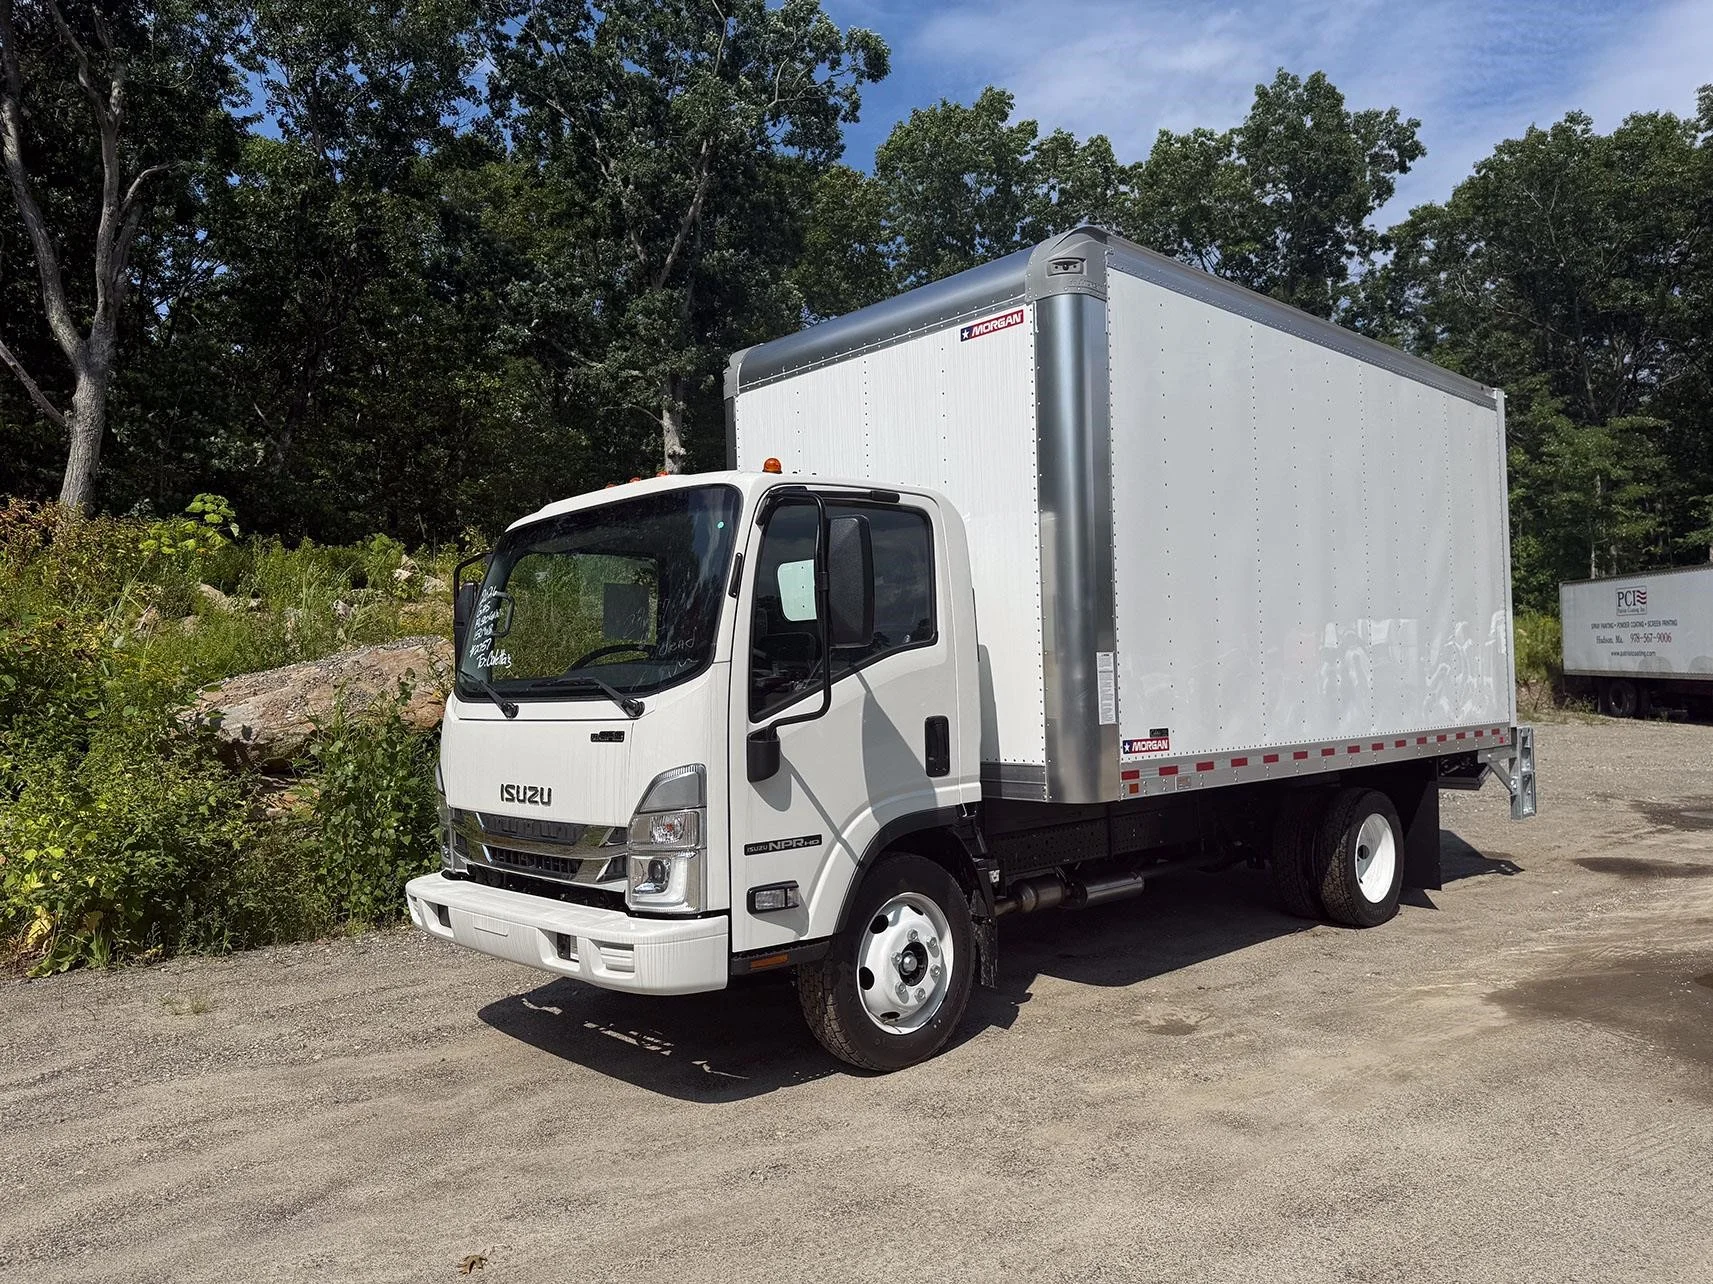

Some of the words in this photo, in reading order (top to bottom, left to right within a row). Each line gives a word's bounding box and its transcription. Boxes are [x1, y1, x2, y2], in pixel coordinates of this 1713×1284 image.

[971, 312, 1023, 337] MORGAN
[1617, 590, 1637, 607] PCI
[1630, 632, 1672, 644] 978-567-9006
[1131, 739, 1169, 752] MORGAN
[500, 783, 552, 807] ISUZU
[747, 844, 768, 853] ISUZU
